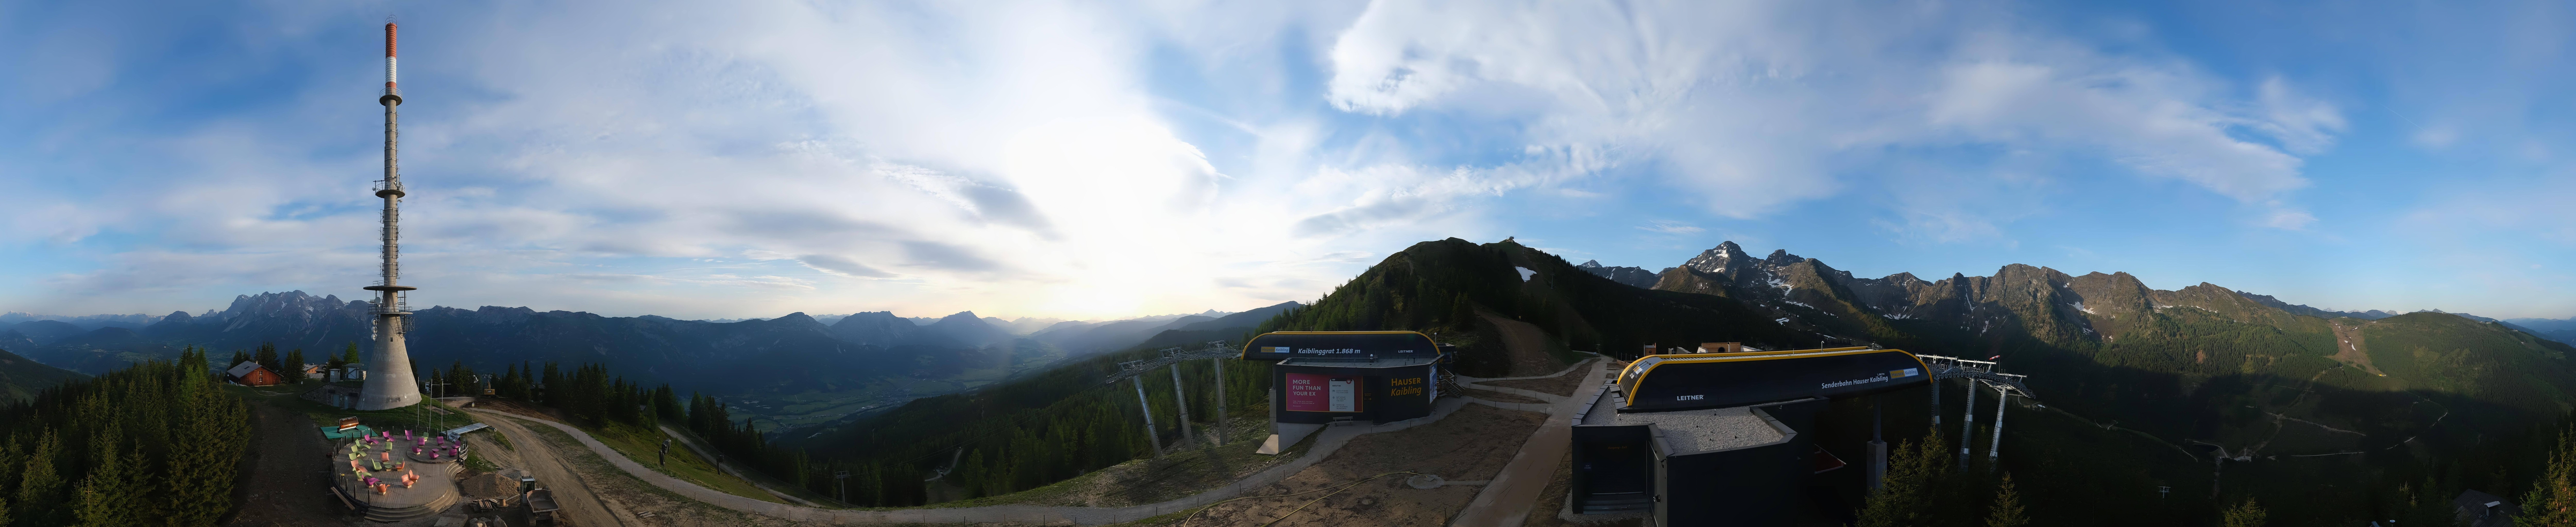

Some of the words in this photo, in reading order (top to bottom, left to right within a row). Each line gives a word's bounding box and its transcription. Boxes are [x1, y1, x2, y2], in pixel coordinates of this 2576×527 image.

[1392, 378, 1421, 386] HAUSER
[1822, 380, 1852, 389] Senderbahn
[1391, 386, 1422, 396] Kaibling
